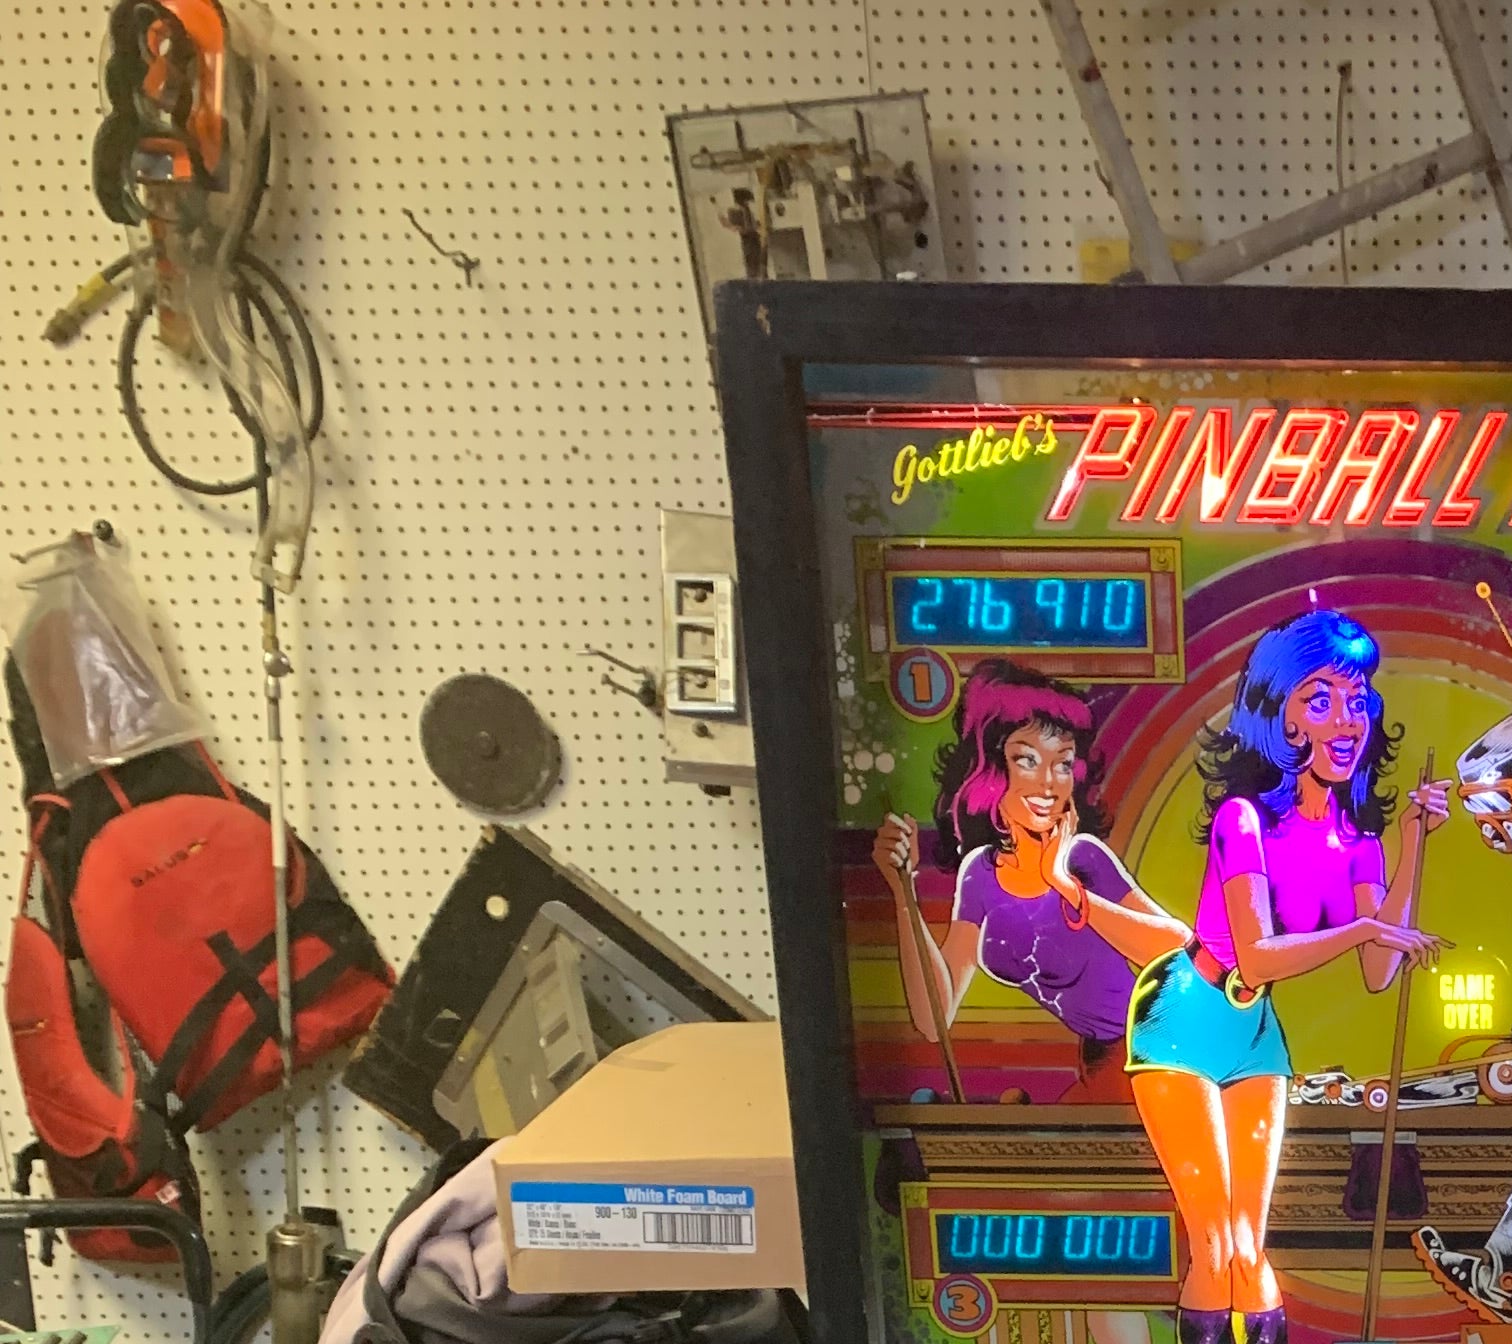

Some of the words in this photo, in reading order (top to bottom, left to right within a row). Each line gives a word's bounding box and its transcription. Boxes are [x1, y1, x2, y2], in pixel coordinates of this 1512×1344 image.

[891, 412, 1058, 505] Gottlieb's
[1045, 406, 1507, 527] PINBALL
[911, 577, 1012, 632] 276
[1035, 578, 1136, 632] 910
[908, 662, 935, 702] 1
[1439, 974, 1495, 1001] GAME
[1443, 1003, 1493, 1030] OVER
[624, 1187, 664, 1203] White
[667, 1188, 705, 1204] Foam
[707, 1189, 747, 1205] Board
[950, 1214, 1045, 1260] 000
[1063, 1215, 1157, 1261] 000
[946, 1283, 983, 1321] 3
